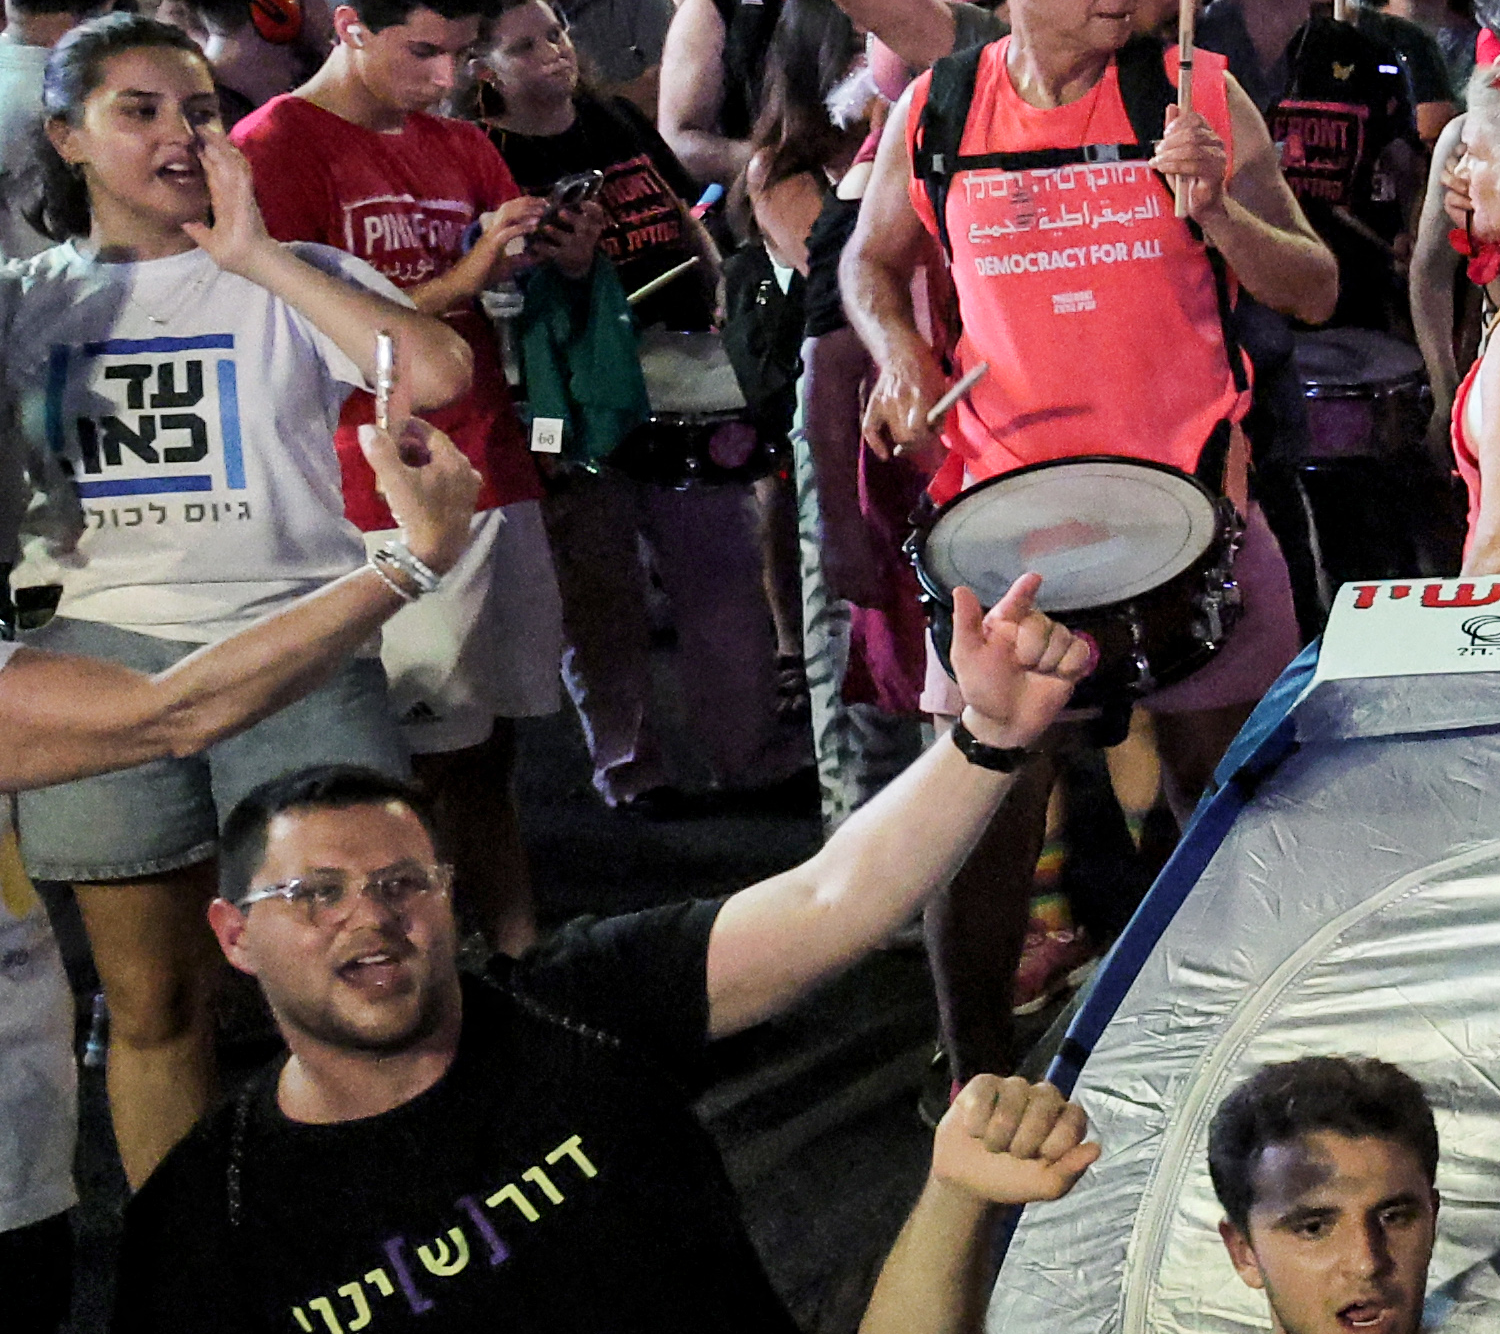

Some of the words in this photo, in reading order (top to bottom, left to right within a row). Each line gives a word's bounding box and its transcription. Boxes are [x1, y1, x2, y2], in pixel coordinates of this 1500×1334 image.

[974, 246, 1087, 276] DEMOCRACY
[1090, 243, 1129, 265] FOR
[1133, 239, 1163, 260] ALL
[105, 360, 204, 409] עד
[77, 414, 208, 474] כאן
[82, 503, 166, 529] לכול
